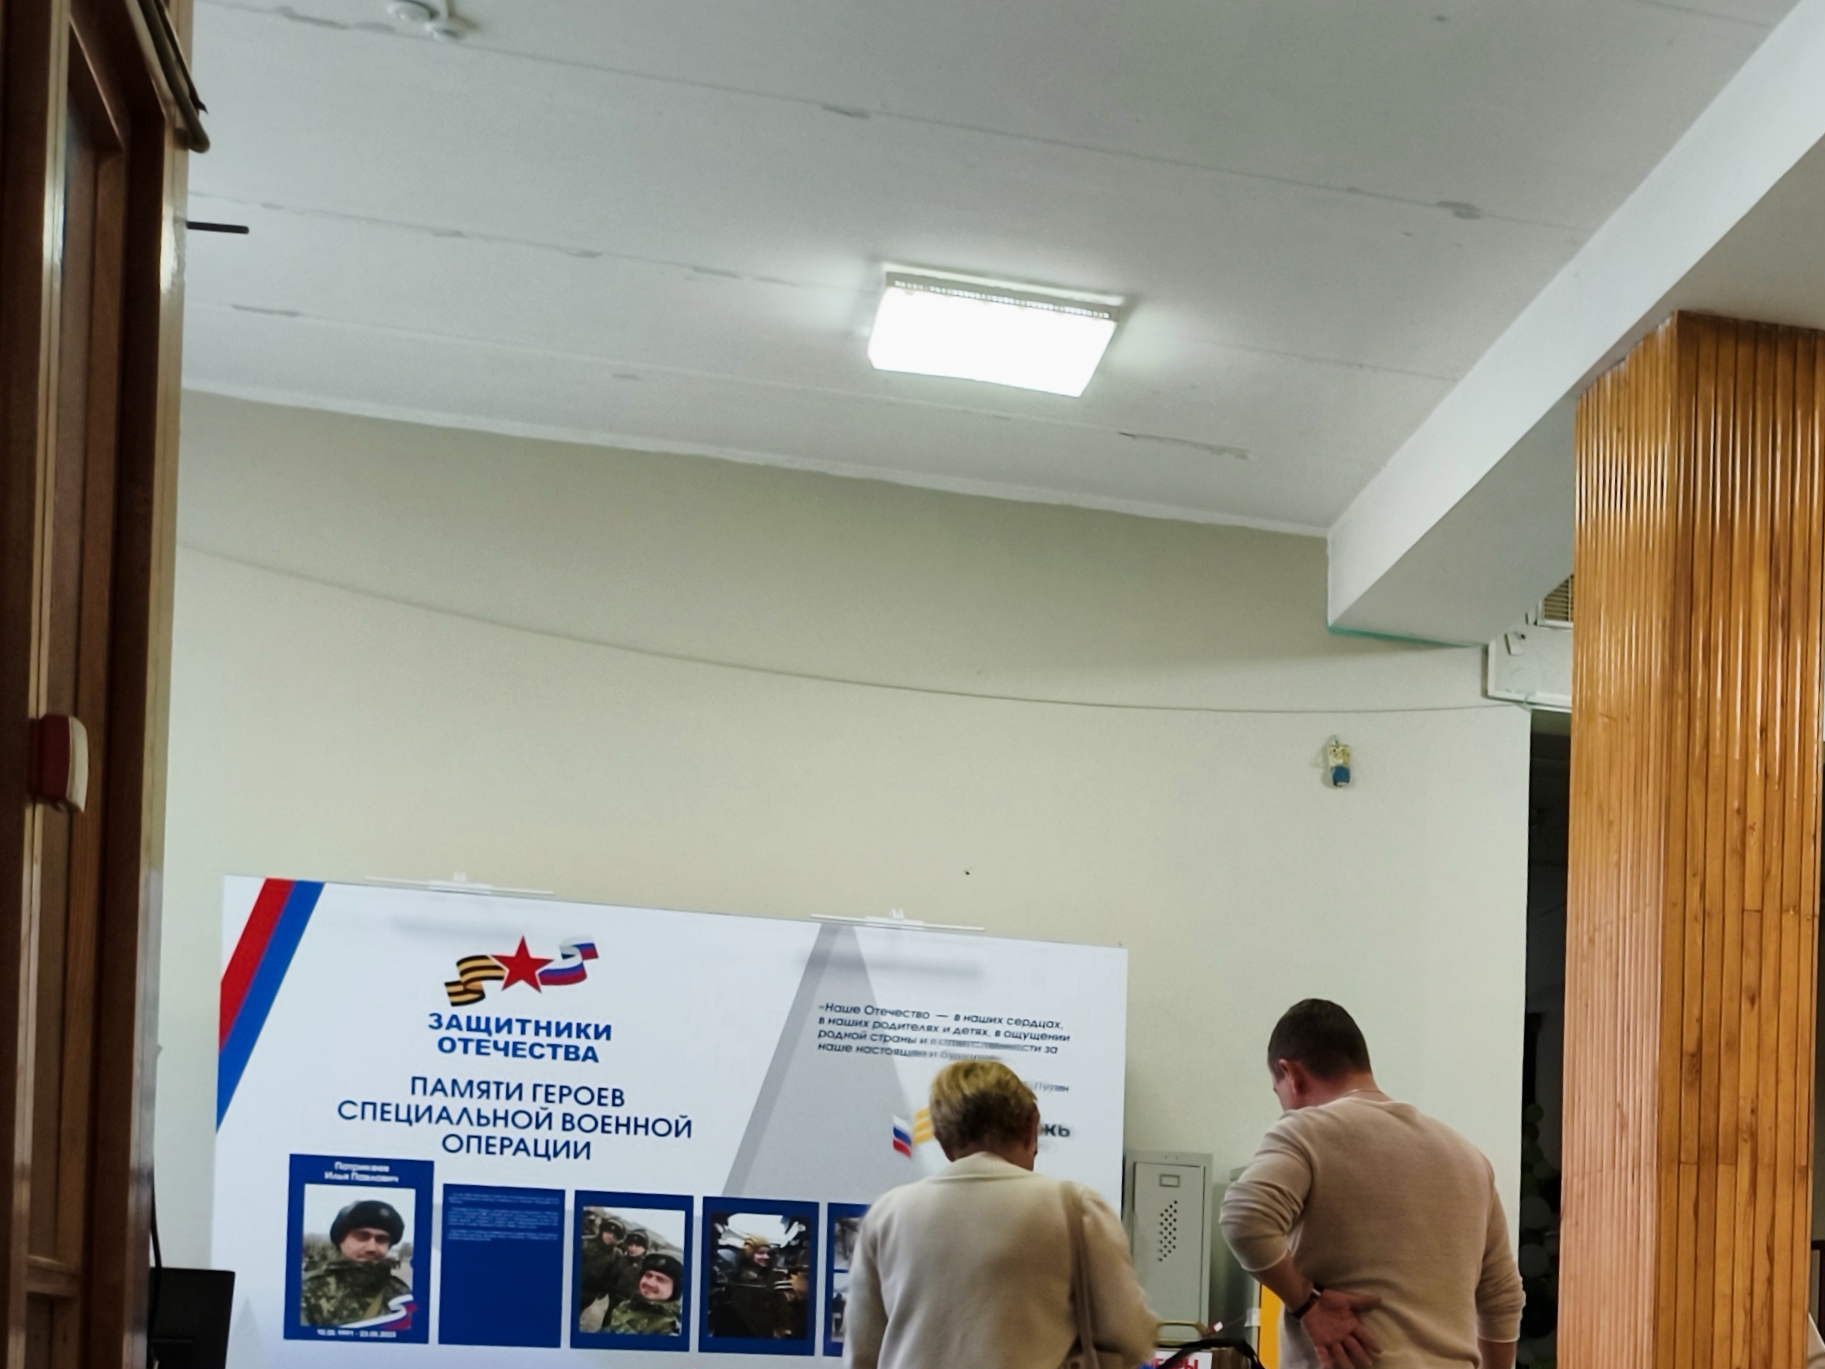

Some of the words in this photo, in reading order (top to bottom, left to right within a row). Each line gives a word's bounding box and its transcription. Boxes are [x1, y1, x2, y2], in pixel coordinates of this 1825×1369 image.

[428, 1012, 612, 1041] ЗАЩИТНИКИ
[818, 1017, 825, 1025] в
[827, 1017, 869, 1028] наших
[872, 1020, 939, 1034] родителях
[1003, 1030, 1071, 1043] ощущении
[864, 1005, 930, 1020] Отечество
[953, 1014, 961, 1022] в
[963, 1015, 1003, 1025] наших
[1006, 1017, 1063, 1030] сердцах,
[437, 1036, 599, 1063] ОТЕЧЕСТВА
[817, 1029, 867, 1041] родной
[870, 1033, 917, 1045] страны
[1044, 1045, 1059, 1055] за
[818, 1043, 853, 1053] наше
[411, 1076, 523, 1102] ПАМЯТИ
[532, 1083, 625, 1108] ГЕРОЕВ
[337, 1100, 553, 1131] СПЕЦИАЛЬНОЙ
[561, 1112, 692, 1139] ВОЕННОЙ
[441, 1133, 591, 1162] ОПЕРАЦИИ
